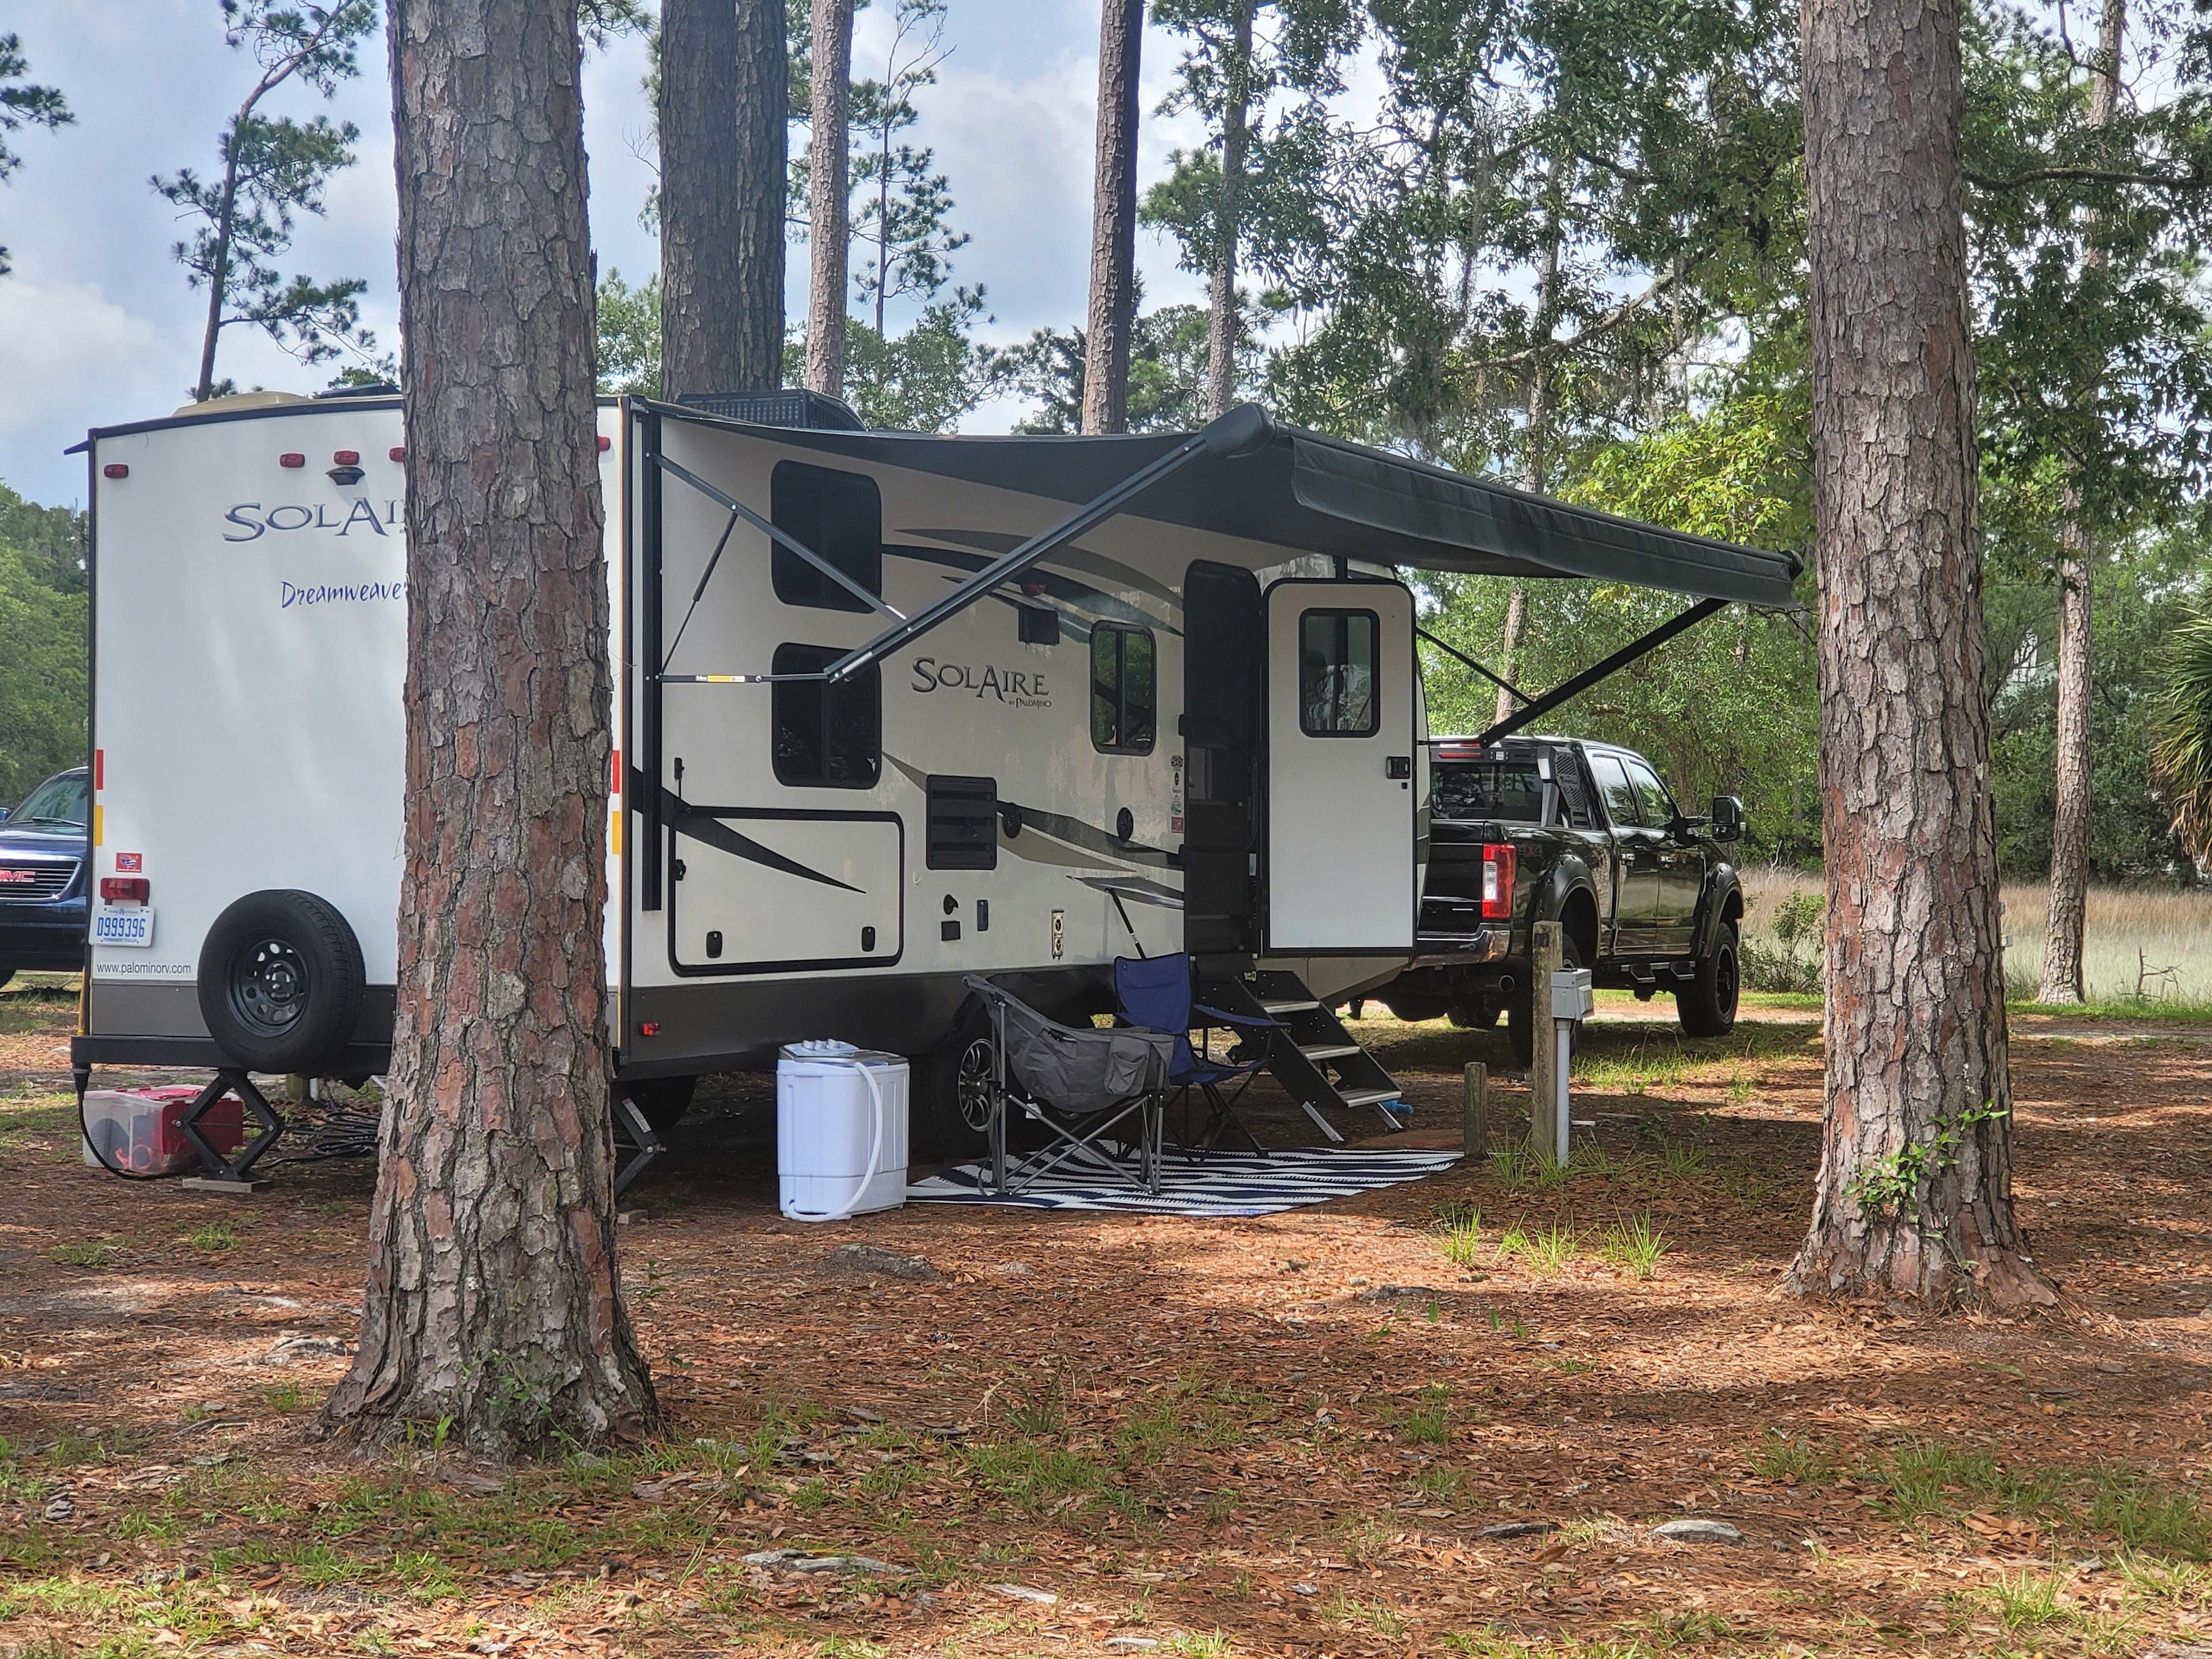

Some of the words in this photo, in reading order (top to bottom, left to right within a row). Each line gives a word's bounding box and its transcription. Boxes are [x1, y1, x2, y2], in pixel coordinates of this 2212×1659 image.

[222, 497, 406, 542] SOLAI
[281, 581, 407, 608] Dreamweave
[911, 657, 1050, 703] SOLAIRE
[97, 916, 146, 938] D999396
[97, 962, 191, 975] www.palominorv.com
